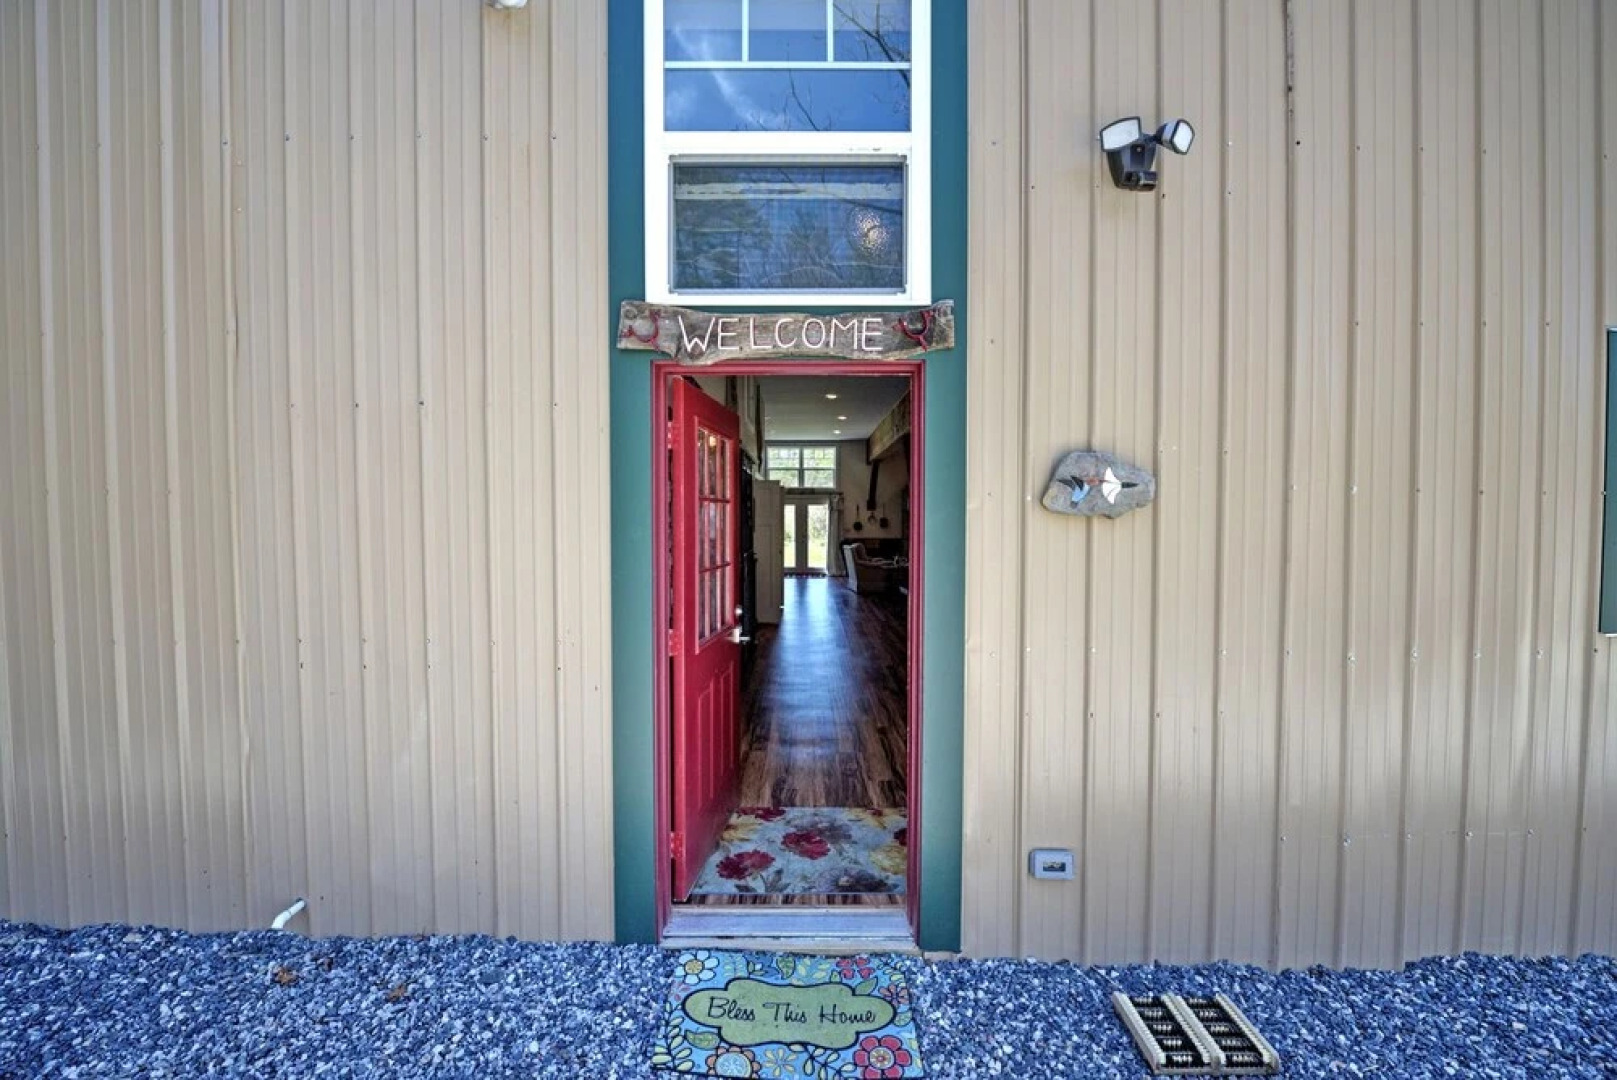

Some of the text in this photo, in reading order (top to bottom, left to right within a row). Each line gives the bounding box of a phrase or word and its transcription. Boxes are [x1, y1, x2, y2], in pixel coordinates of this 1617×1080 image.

[678, 315, 883, 352] WELCOME
[707, 996, 875, 1024] Bless This Home
